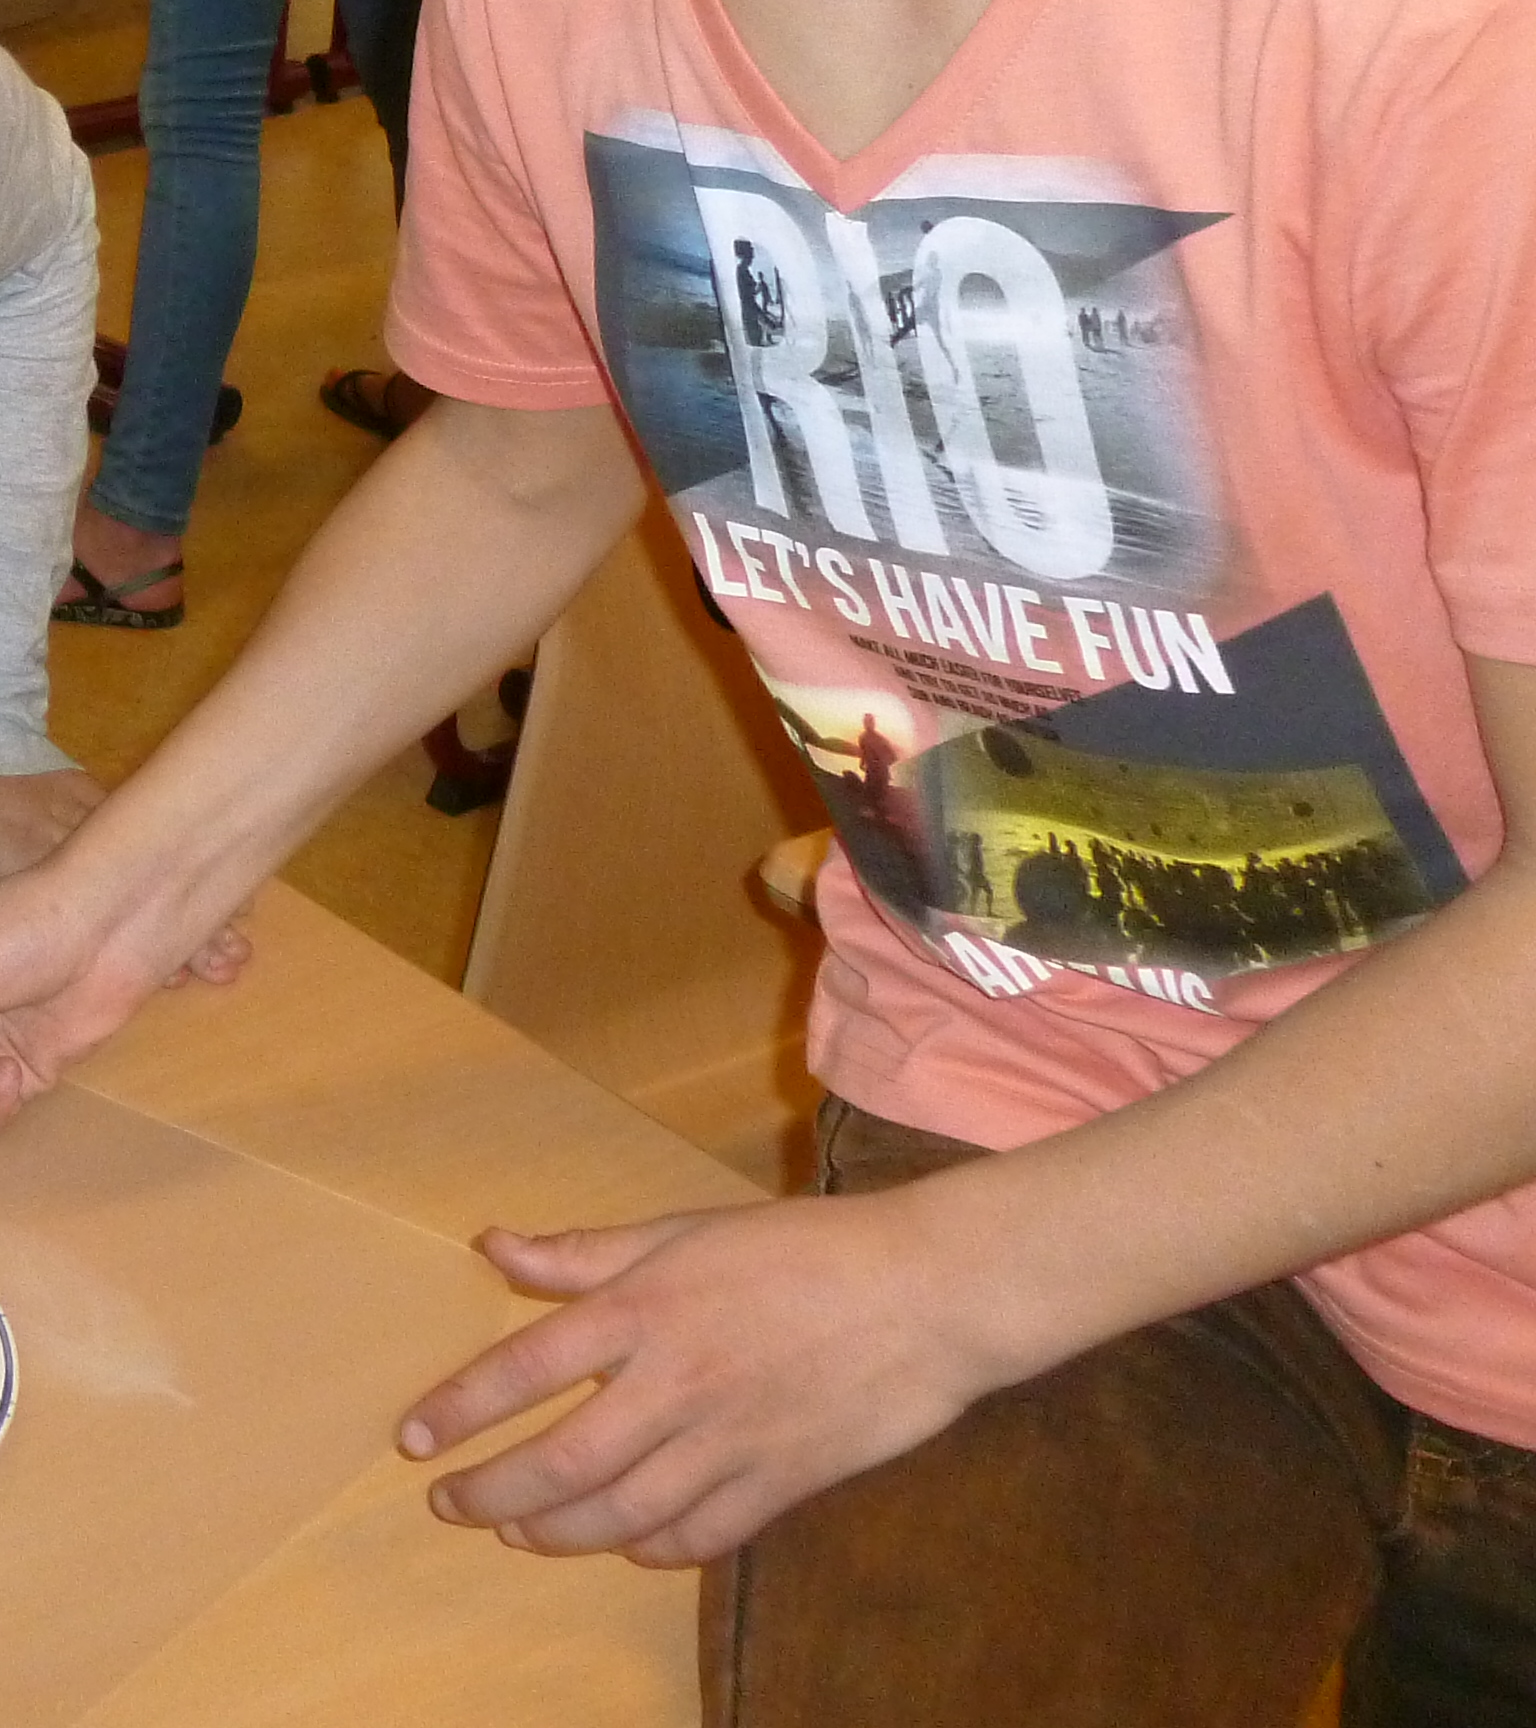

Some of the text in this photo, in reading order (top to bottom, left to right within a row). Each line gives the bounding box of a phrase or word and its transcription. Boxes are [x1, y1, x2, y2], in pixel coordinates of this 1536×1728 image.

[693, 184, 1115, 581] RIO
[692, 510, 1236, 696] LET'S HAVE FUN
